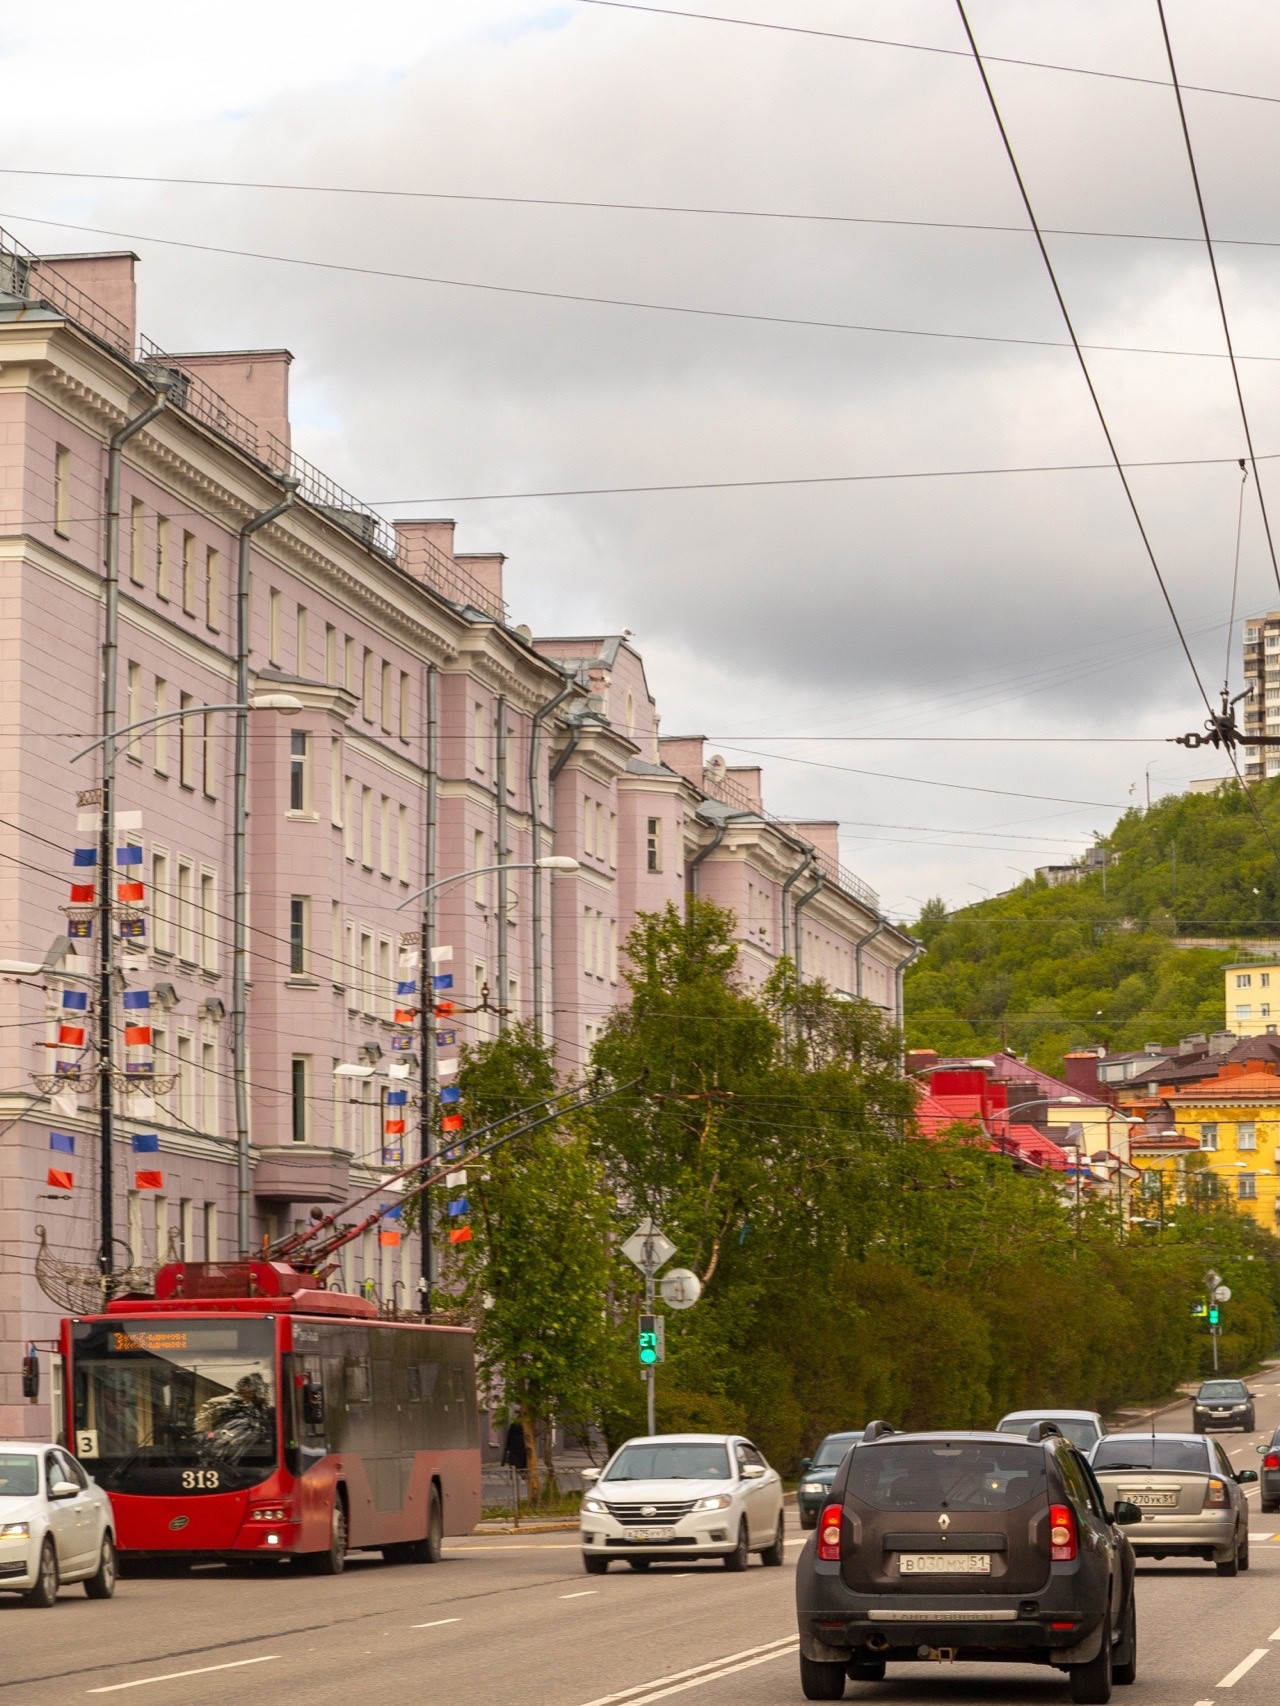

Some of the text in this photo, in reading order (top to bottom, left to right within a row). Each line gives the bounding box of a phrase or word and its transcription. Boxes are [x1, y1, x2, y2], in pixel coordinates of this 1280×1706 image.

[640, 1332, 657, 1347] 27
[81, 1437, 93, 1453] 3
[182, 1470, 219, 1489] 313
[969, 1556, 986, 1568] 51
